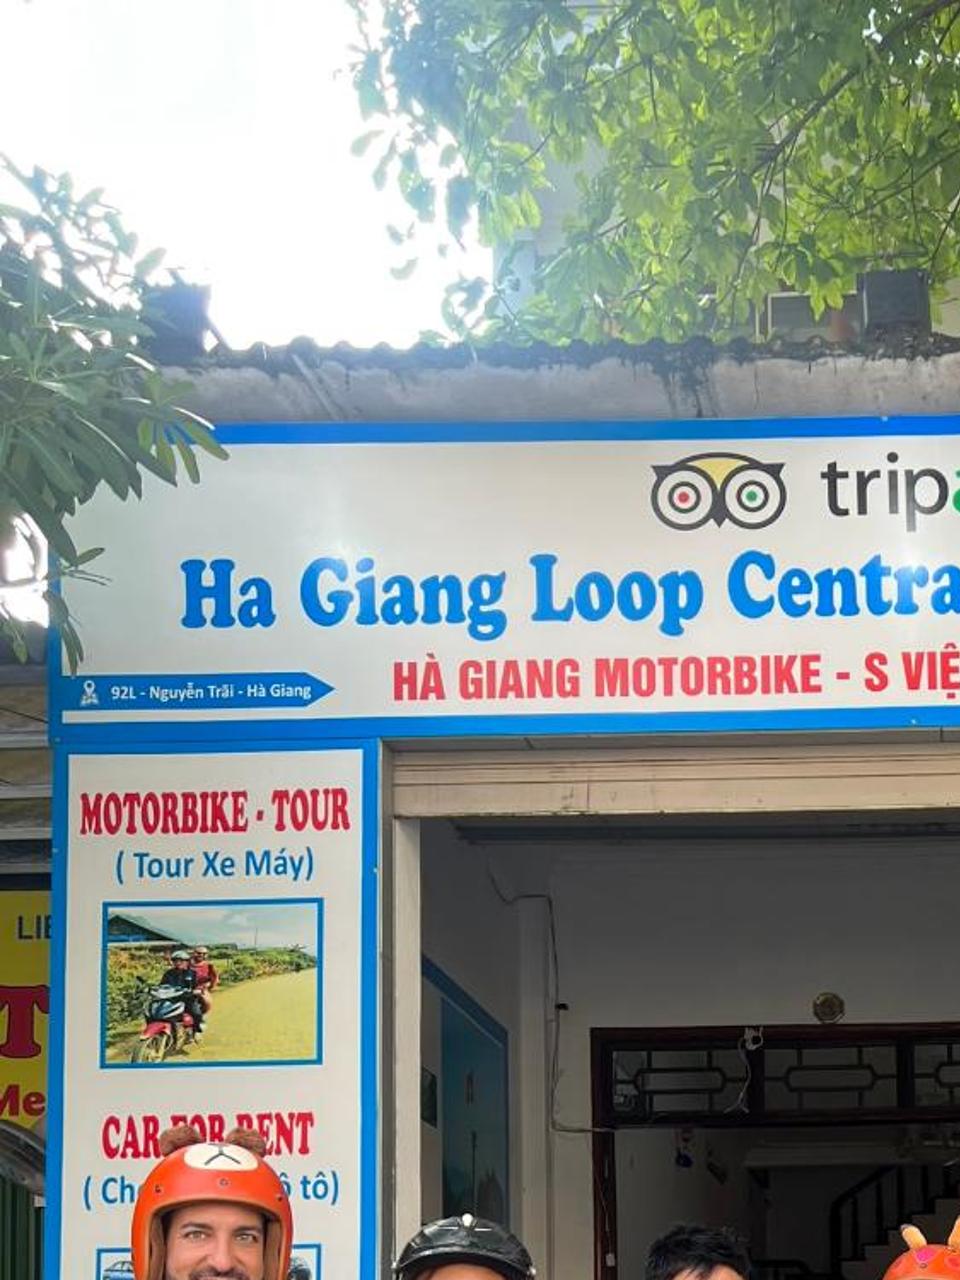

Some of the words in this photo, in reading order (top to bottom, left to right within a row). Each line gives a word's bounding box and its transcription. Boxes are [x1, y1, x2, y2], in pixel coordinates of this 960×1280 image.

[180, 558, 276, 628] Ha
[301, 557, 506, 641] Giang
[530, 554, 704, 636] Loop
[111, 686, 136, 700] 92L
[247, 683, 266, 698] Hà
[270, 683, 311, 700] Giang
[392, 652, 445, 701] HÀ
[459, 657, 580, 699] GIANG
[599, 653, 821, 698] MOTORBIKE
[864, 651, 889, 692] S
[80, 790, 249, 835] MOTORBIKE
[272, 788, 351, 833] TOUR
[133, 852, 195, 880] Tour
[202, 850, 236, 878] Xe
[102, 1114, 161, 1160] CAR
